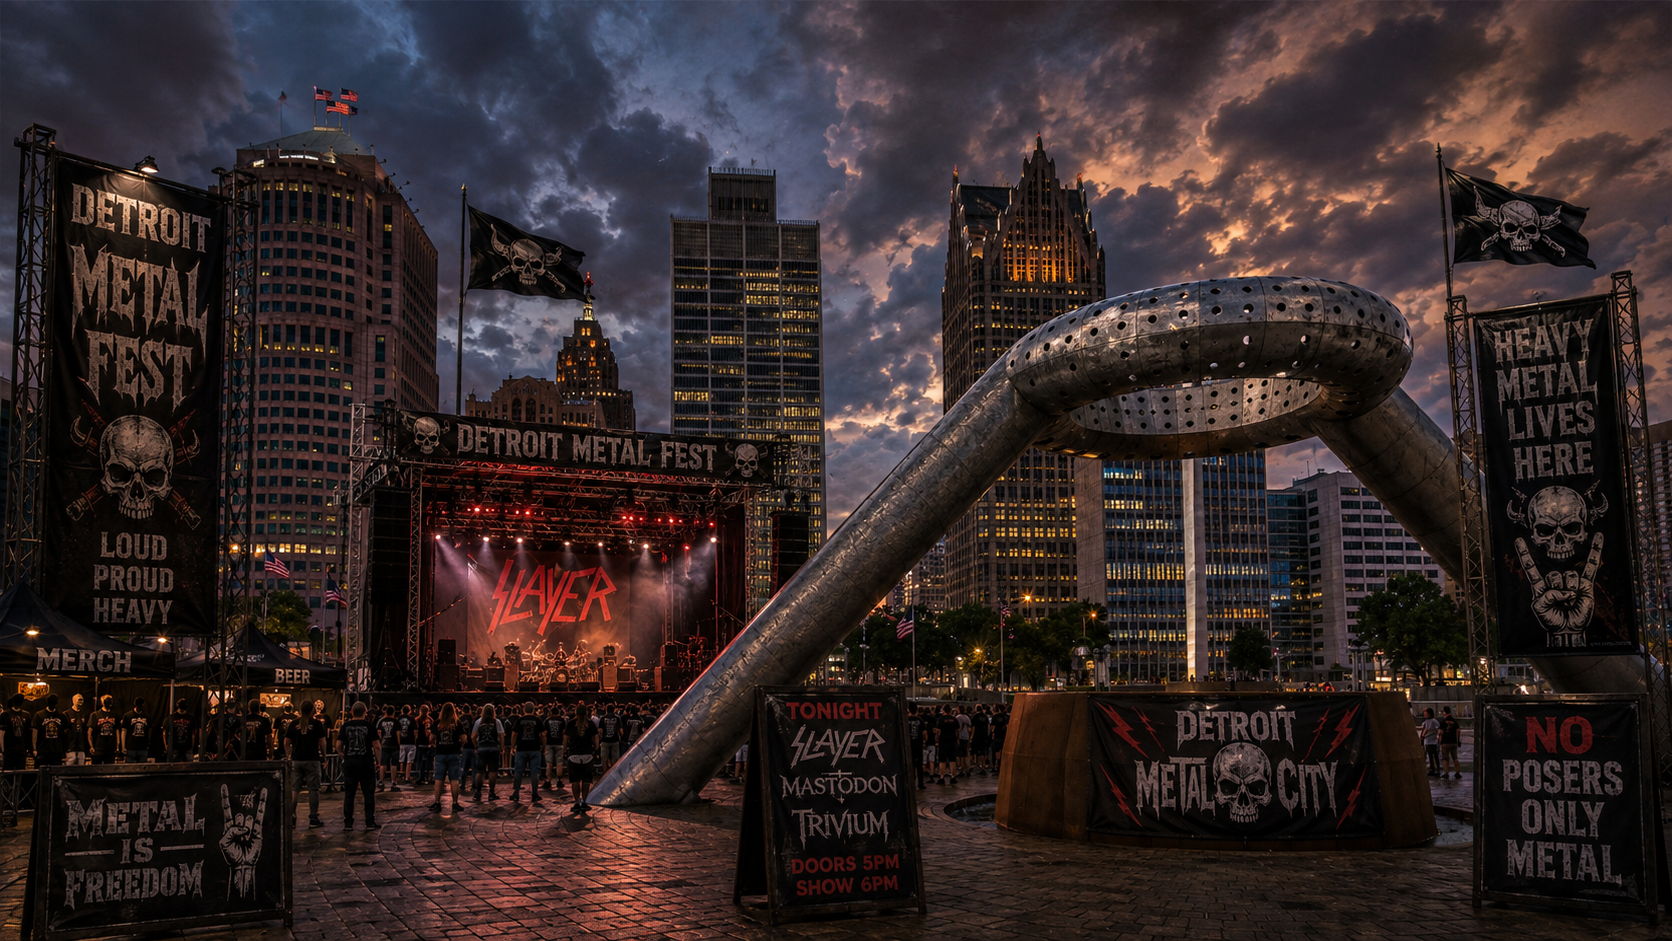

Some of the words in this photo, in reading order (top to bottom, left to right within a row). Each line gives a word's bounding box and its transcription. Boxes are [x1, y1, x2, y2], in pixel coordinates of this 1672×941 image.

[71, 183, 211, 253] DETROIT
[70, 243, 209, 364] METAL
[1493, 317, 1594, 363] HEAVY
[84, 328, 194, 413] FEST
[1495, 359, 1599, 409] METAL
[1506, 400, 1596, 441] LIVES
[456, 423, 563, 461] DETROIT
[571, 433, 652, 468] METAL
[660, 440, 718, 473] FEST
[1512, 441, 1595, 482] HERE
[100, 531, 168, 561] LOUD
[93, 564, 174, 593] PROUD
[486, 558, 618, 636] SLAYER
[93, 597, 173, 625] HEAVY
[36, 647, 132, 674] MERCH
[274, 668, 311, 685] BEER
[786, 702, 882, 720] TONIGHT
[1175, 710, 1297, 751] DETROIT
[790, 724, 886, 769] SLAYER
[1525, 715, 1593, 754] NO
[779, 773, 898, 800] MASTODON
[1133, 756, 1216, 820] METAL
[1277, 757, 1339, 819] CITY
[1502, 758, 1624, 796] POSERS
[65, 793, 206, 843] METAL
[791, 808, 890, 850] TRIVIUM
[1521, 798, 1605, 839] ONLY
[120, 837, 154, 864] IS
[791, 856, 857, 875] DOORS
[863, 853, 900, 870] 5PM
[1506, 838, 1622, 887] METAL
[64, 859, 205, 910] FREEDOM
[796, 877, 854, 896] SHOW
[861, 875, 899, 892] 6PM
